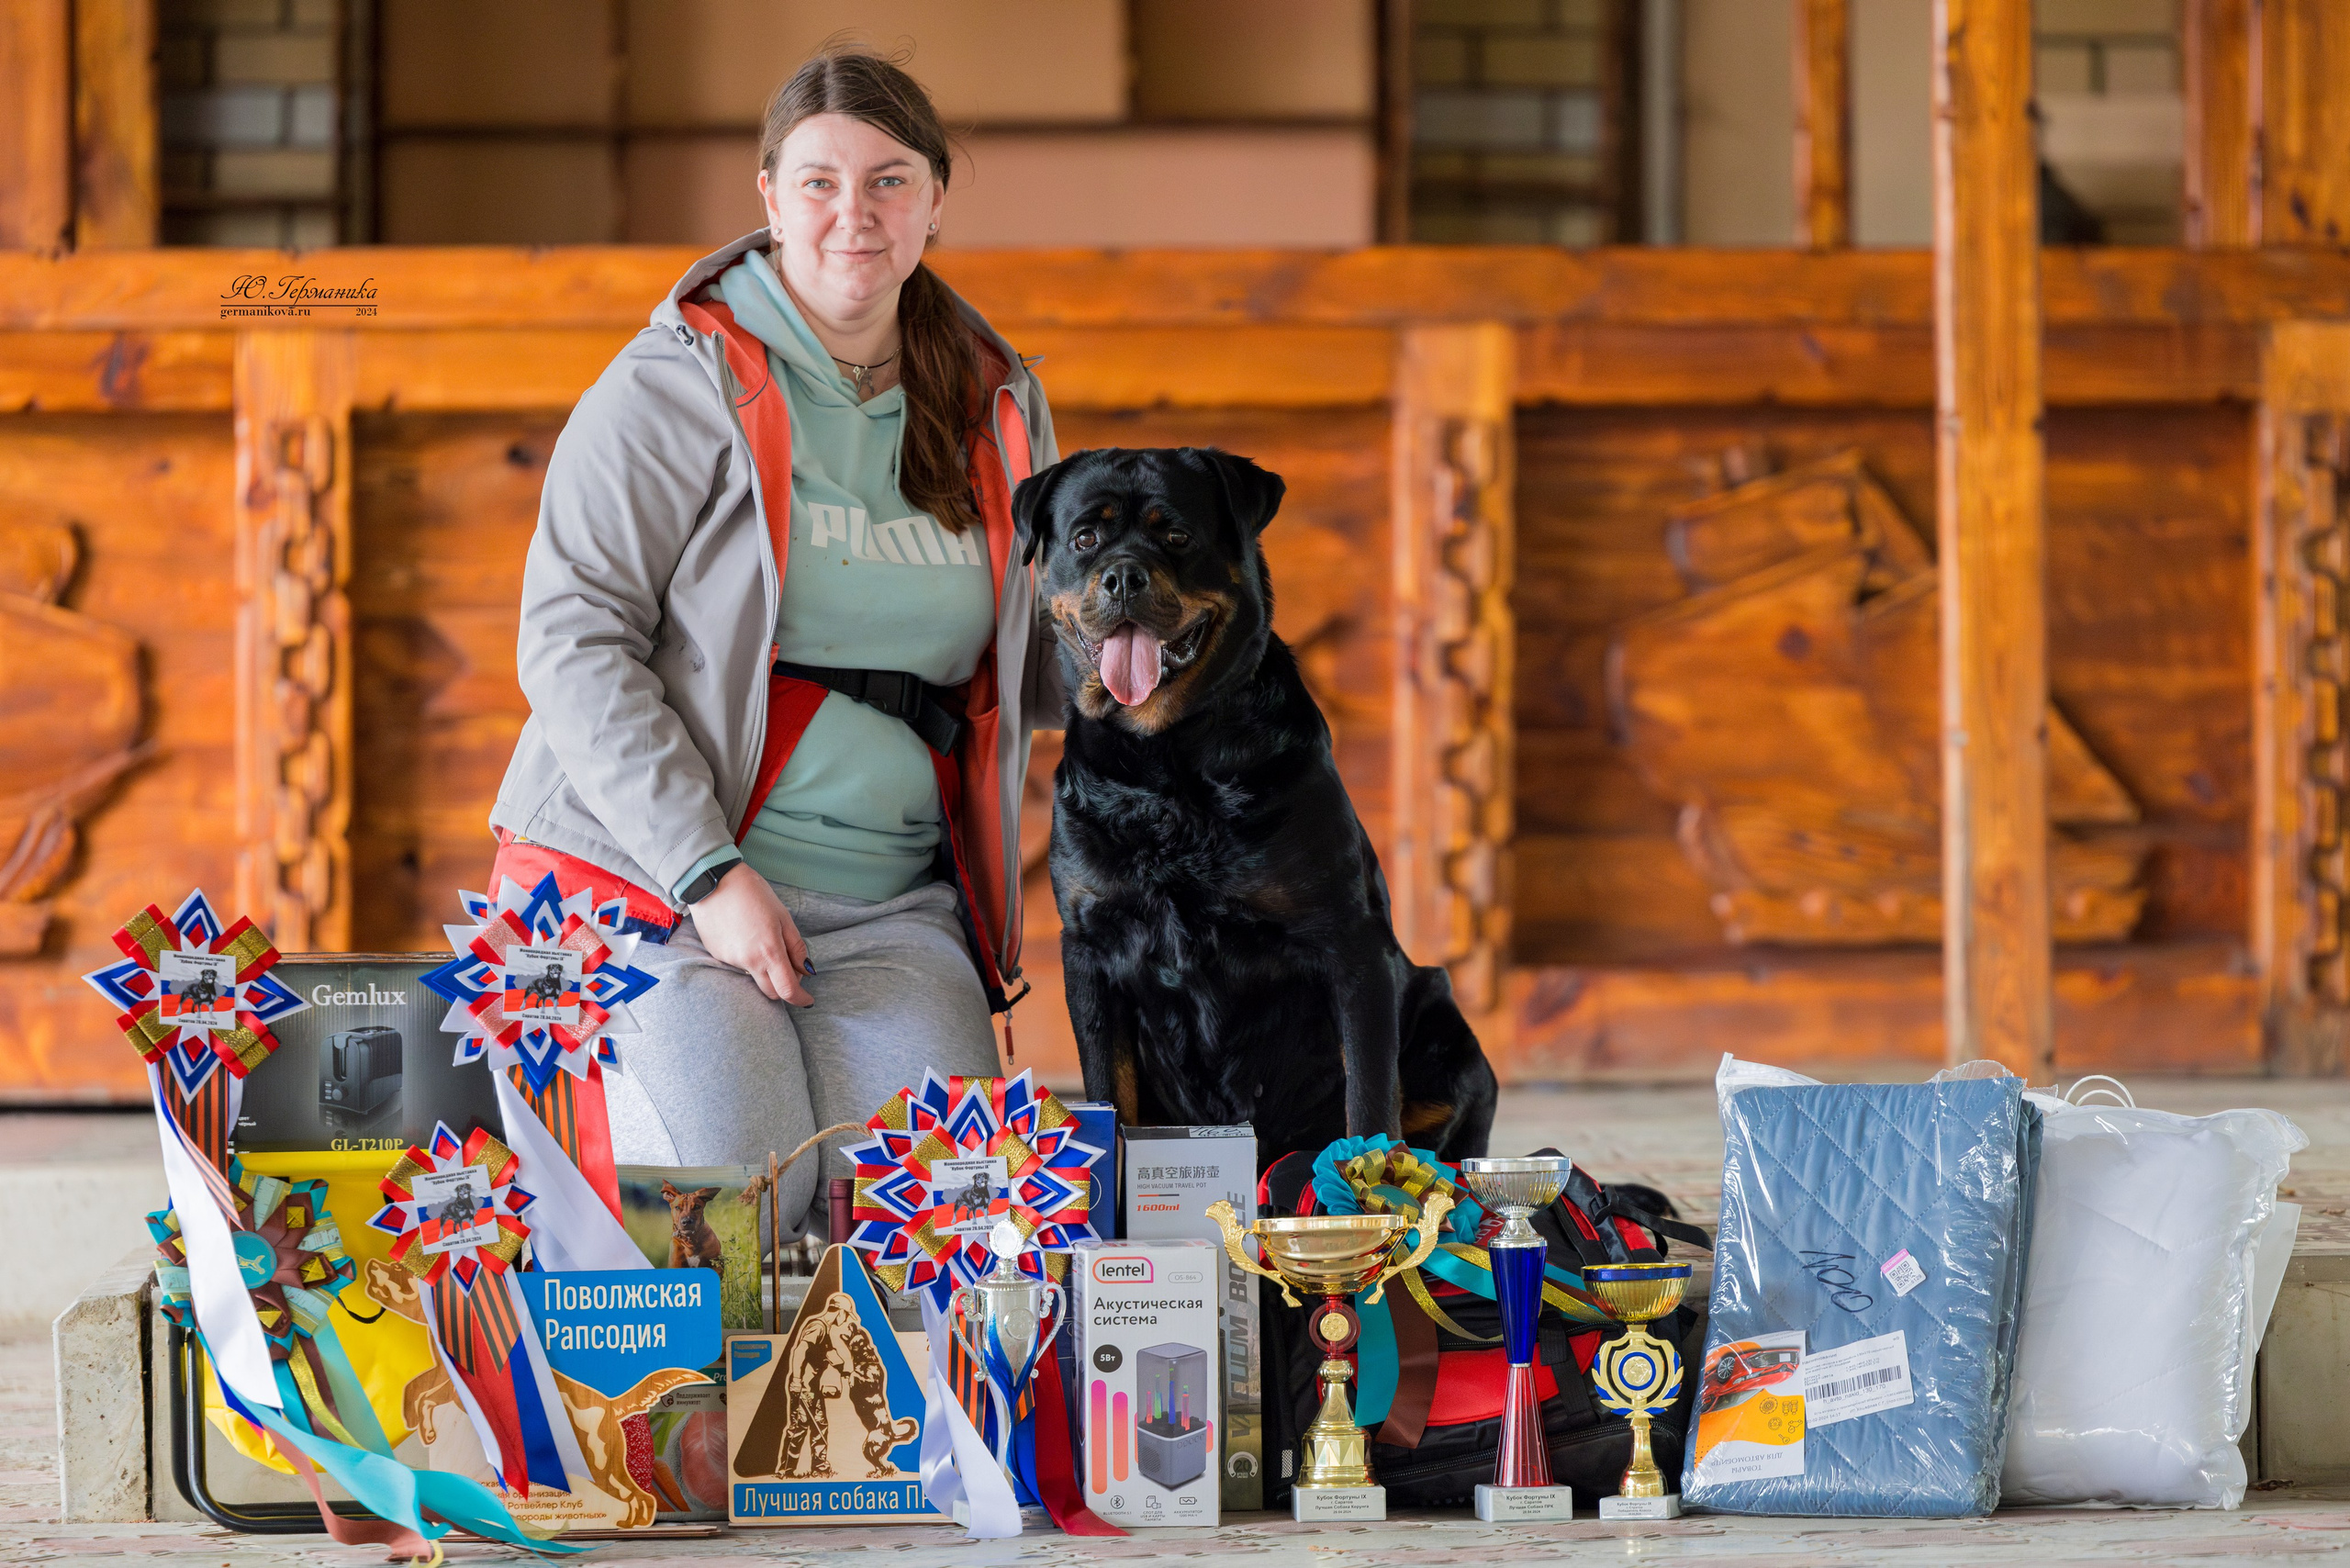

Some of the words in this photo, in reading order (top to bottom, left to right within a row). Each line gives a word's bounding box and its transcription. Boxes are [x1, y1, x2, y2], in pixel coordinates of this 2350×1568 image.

[312, 983, 407, 1006] Gemlux
[330, 1138, 404, 1151] GL-T210P
[1137, 1165, 1220, 1181] 高真空旅游壶
[1136, 1204, 1181, 1212] 1600ml
[1102, 1262, 1145, 1277] lentel
[544, 1279, 701, 1311] Поволжская
[1093, 1297, 1203, 1313] Акустическая
[1093, 1316, 1158, 1326] система
[545, 1318, 666, 1354] Рапсодия
[1731, 1464, 1762, 1473] ТОВАРЫ
[508, 1500, 558, 1510] Ротвейлер
[560, 1500, 583, 1509] Клуб
[743, 1487, 822, 1518] Лучшая
[829, 1484, 899, 1511] собака
